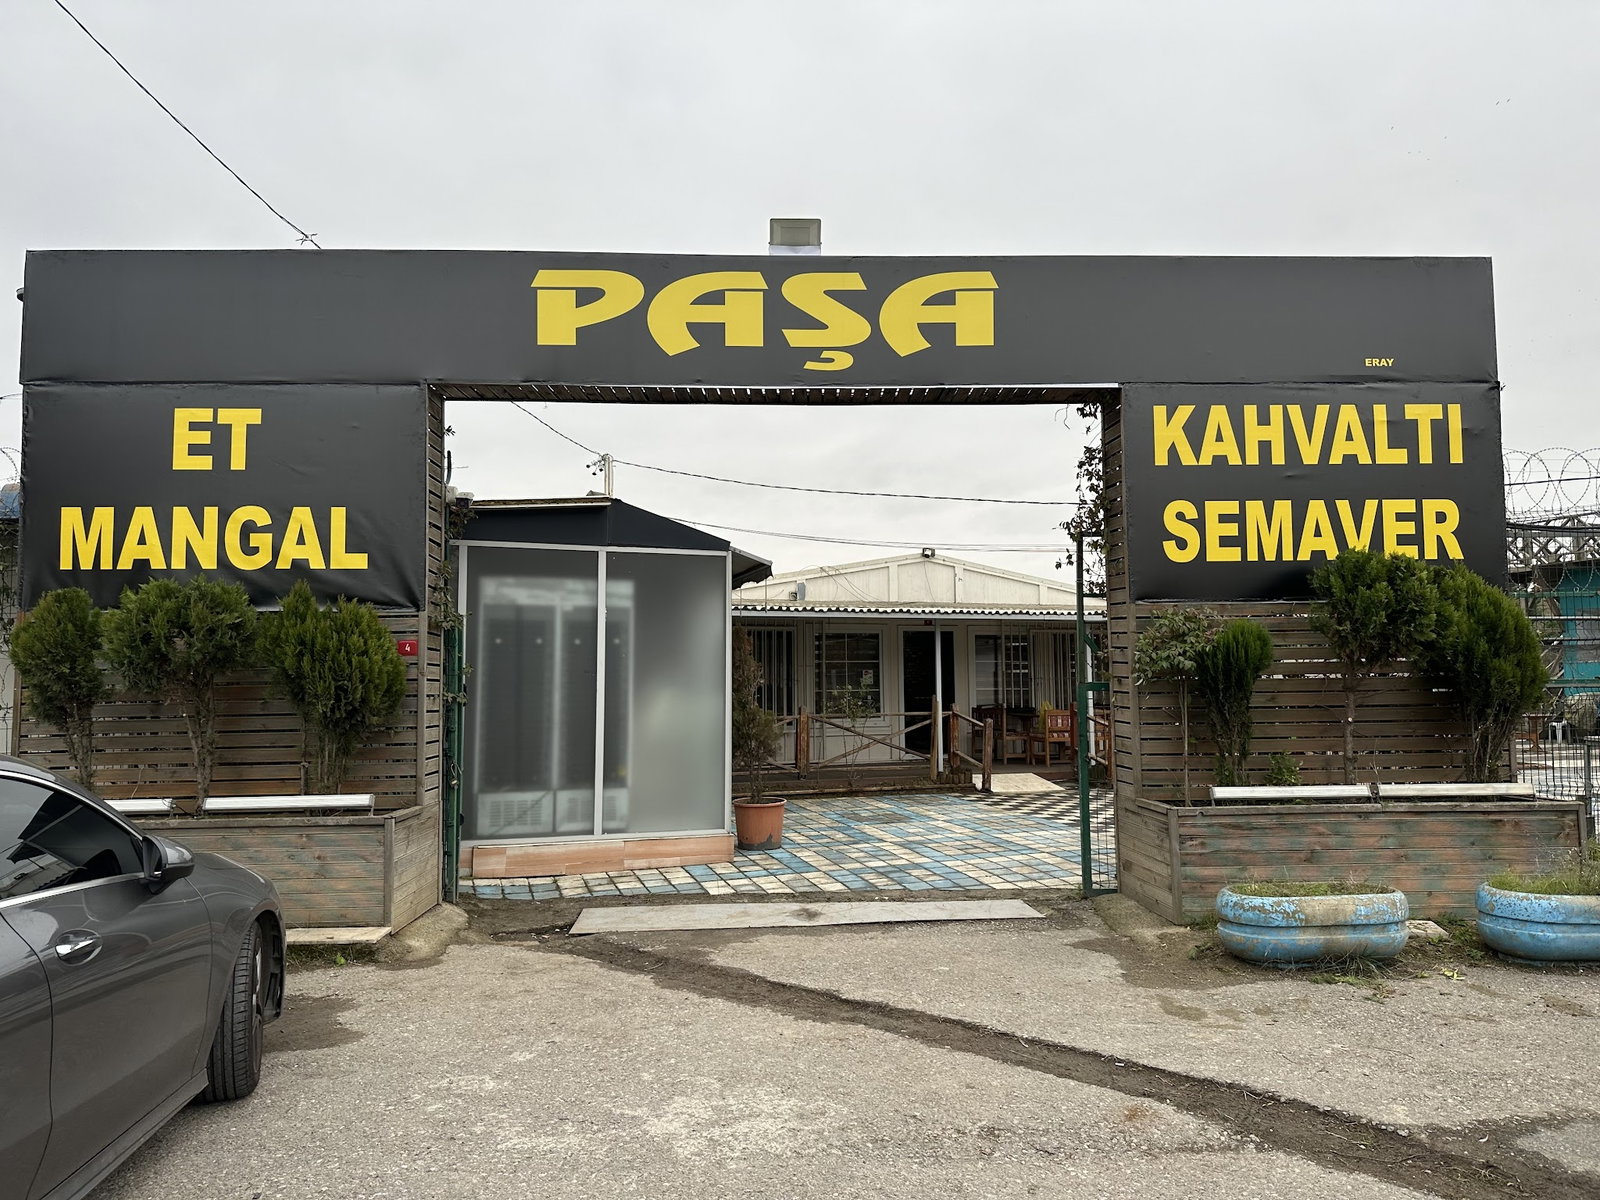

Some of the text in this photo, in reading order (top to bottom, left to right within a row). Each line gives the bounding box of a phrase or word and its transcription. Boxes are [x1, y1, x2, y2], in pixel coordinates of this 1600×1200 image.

[531, 269, 998, 371] PAŞA
[1364, 358, 1395, 367] ERAY
[172, 407, 264, 472] ET
[1152, 403, 1465, 467] KAHVALTI
[58, 506, 369, 571] MANGAL
[1162, 499, 1465, 563] SEMAVER
[404, 643, 411, 652] 4
